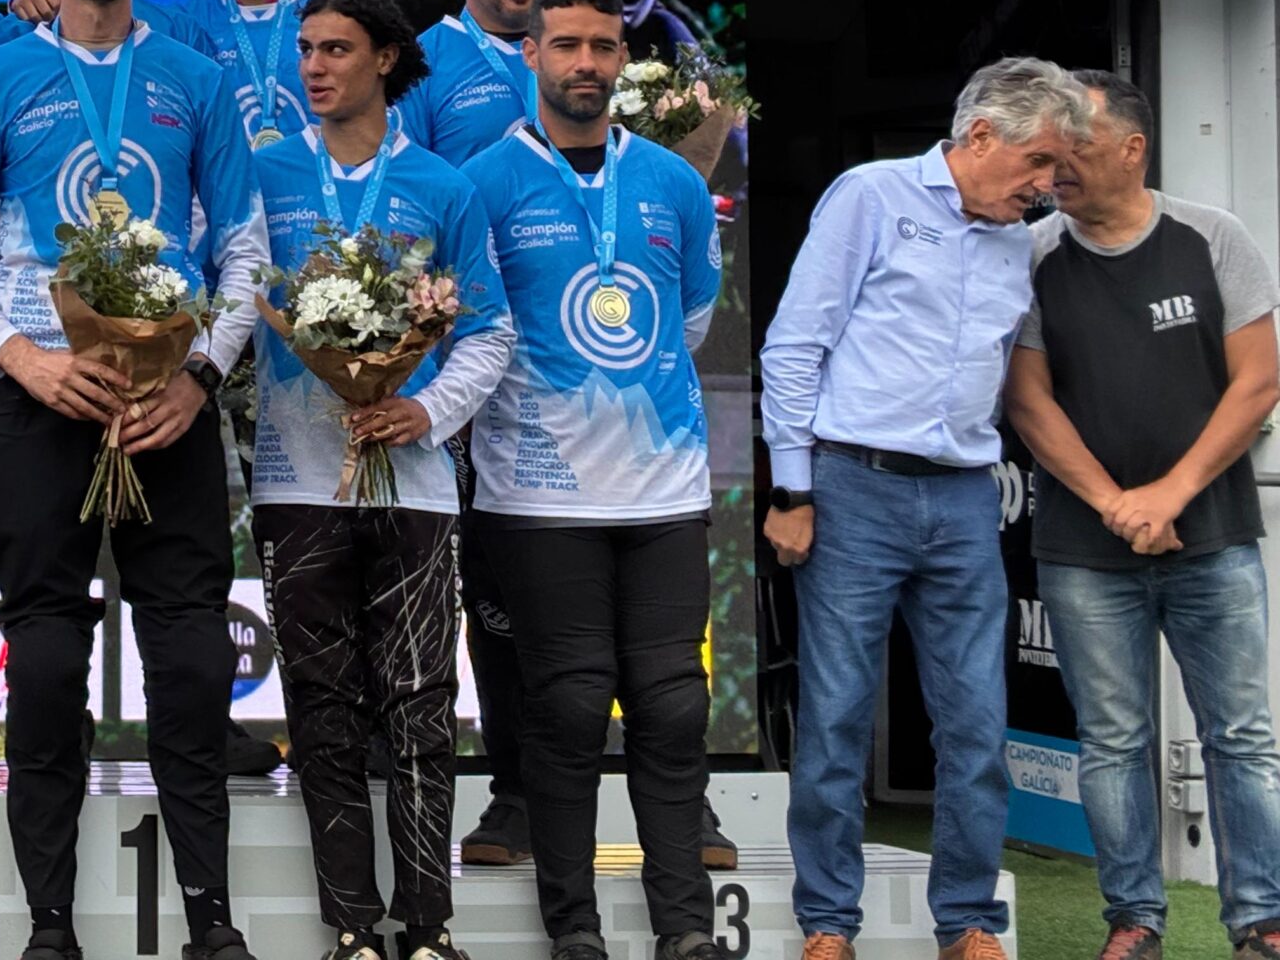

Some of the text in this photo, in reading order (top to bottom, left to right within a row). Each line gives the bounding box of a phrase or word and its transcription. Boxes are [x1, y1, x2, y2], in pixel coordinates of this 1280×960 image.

[510, 220, 578, 238] Campión
[10, 306, 52, 318] ENDURO
[1149, 295, 1195, 324] MB
[519, 401, 539, 411] XCO
[518, 440, 559, 451] ENDURO
[517, 449, 560, 461] ESTRADA
[515, 459, 571, 471] CICLOCROS
[515, 469, 577, 481] RESISTENCIA
[514, 478, 580, 492] PUMP TRACK
[1009, 743, 1072, 772] CAMPIONATO
[1021, 772, 1060, 795] GALICIA
[120, 814, 158, 955] 1
[716, 883, 751, 960] 3
